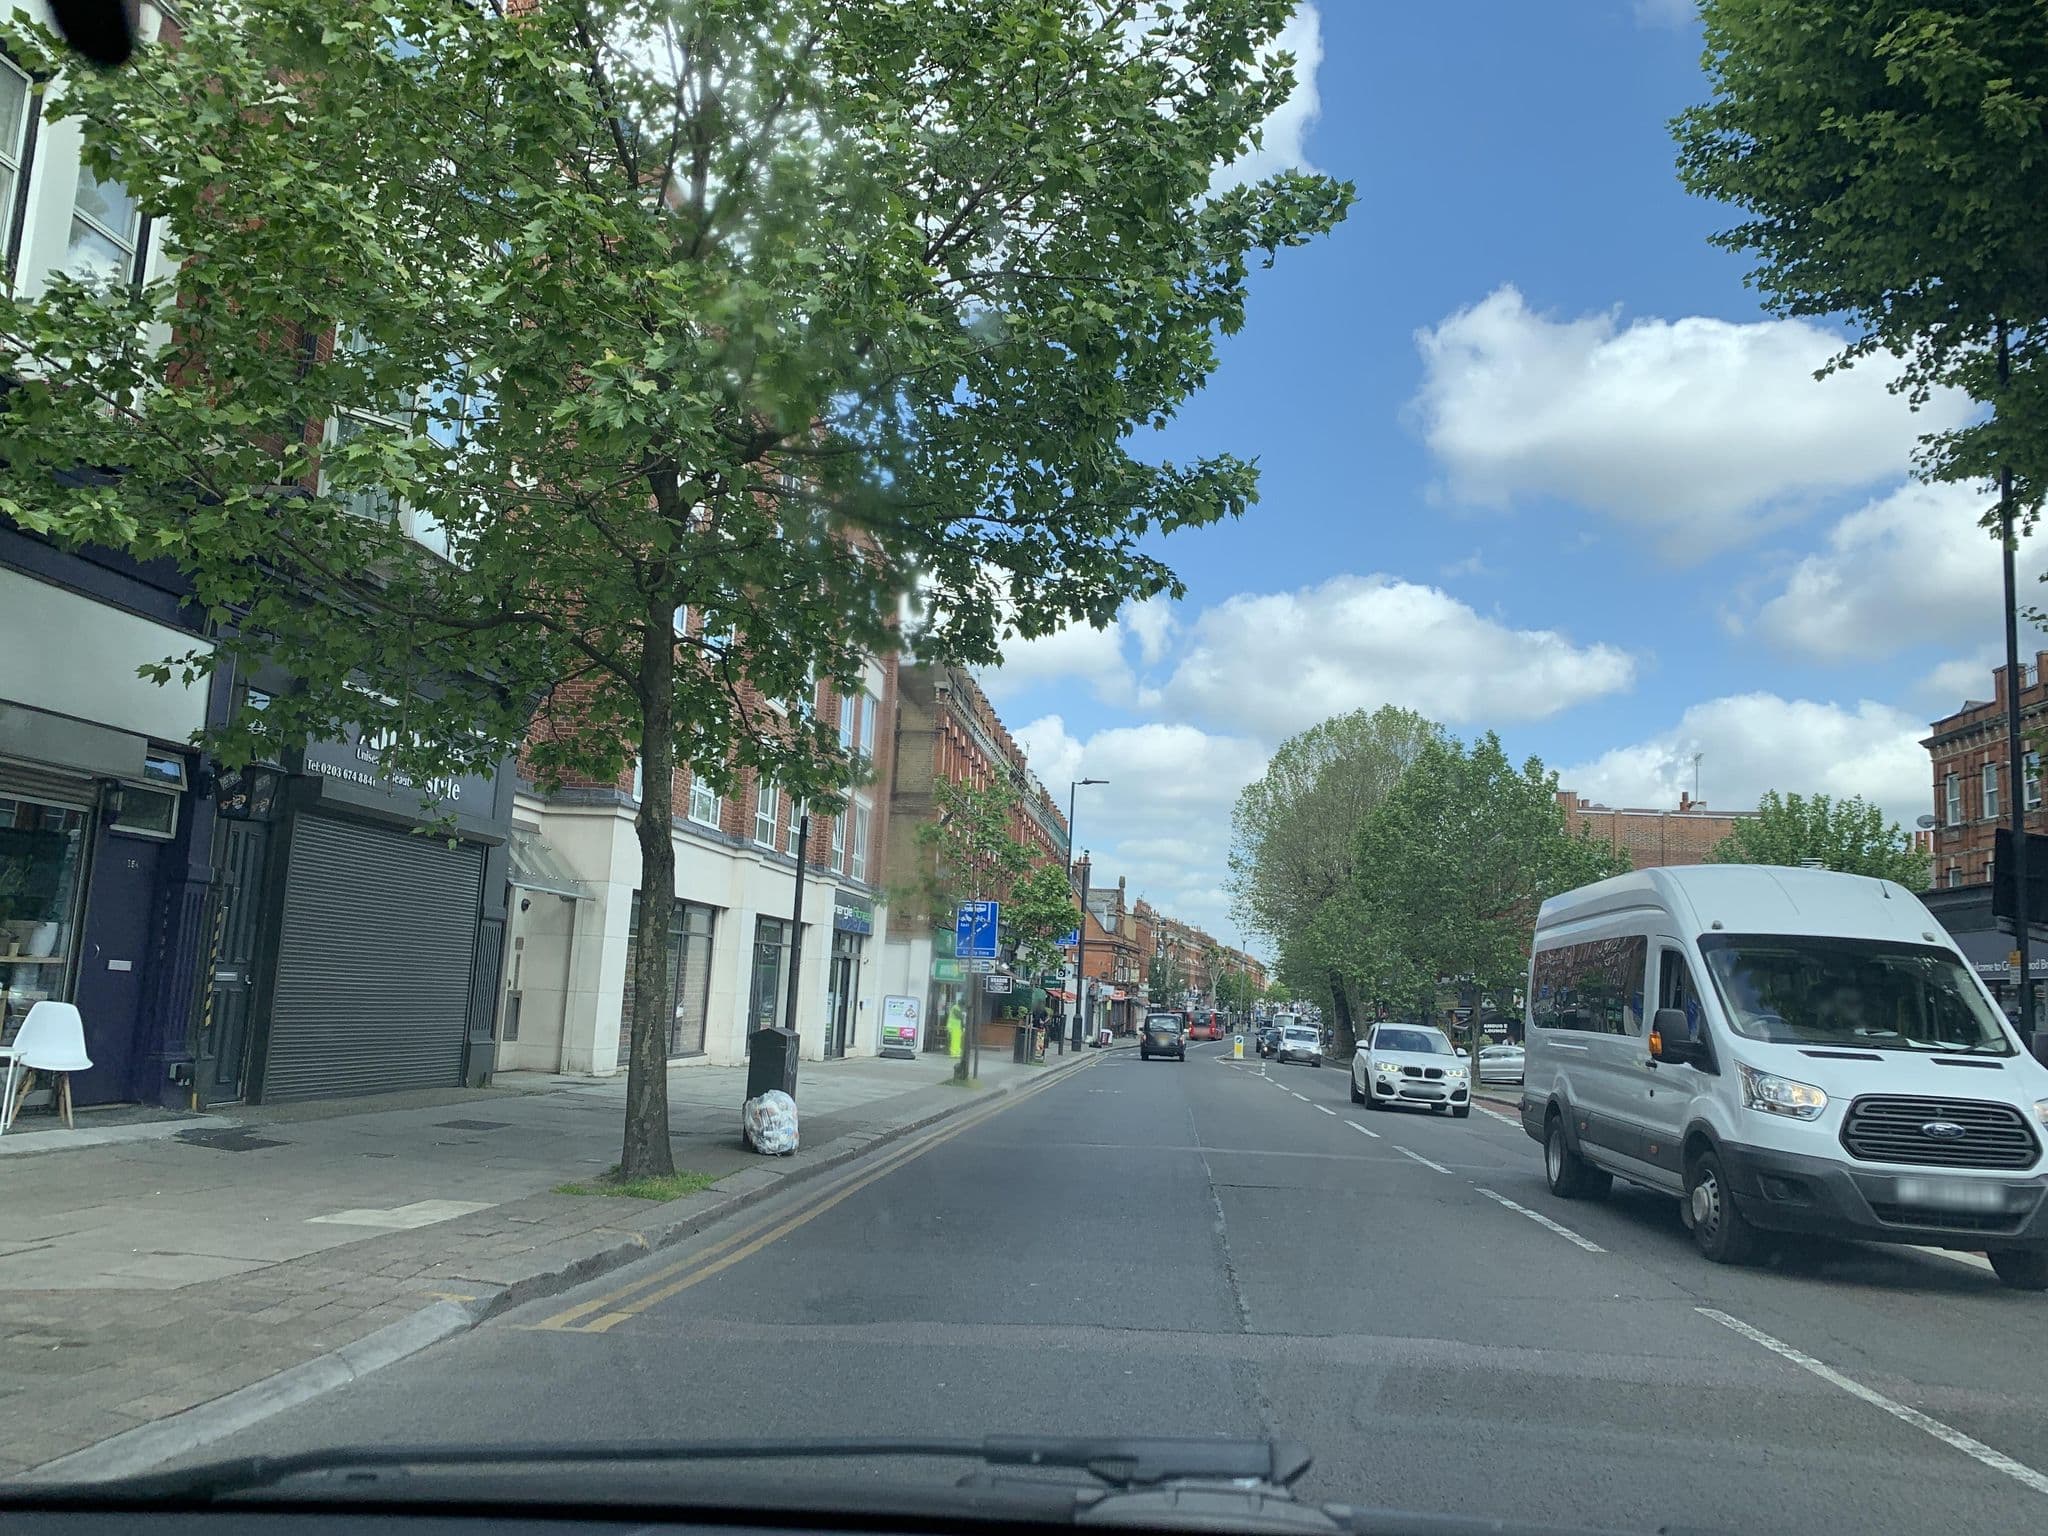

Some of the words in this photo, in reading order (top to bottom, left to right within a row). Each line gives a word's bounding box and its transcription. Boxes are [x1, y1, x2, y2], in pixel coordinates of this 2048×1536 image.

[307, 758, 320, 772] Tel:
[320, 762, 342, 778] 0203
[343, 768, 357, 782] 674
[425, 775, 461, 801] style
